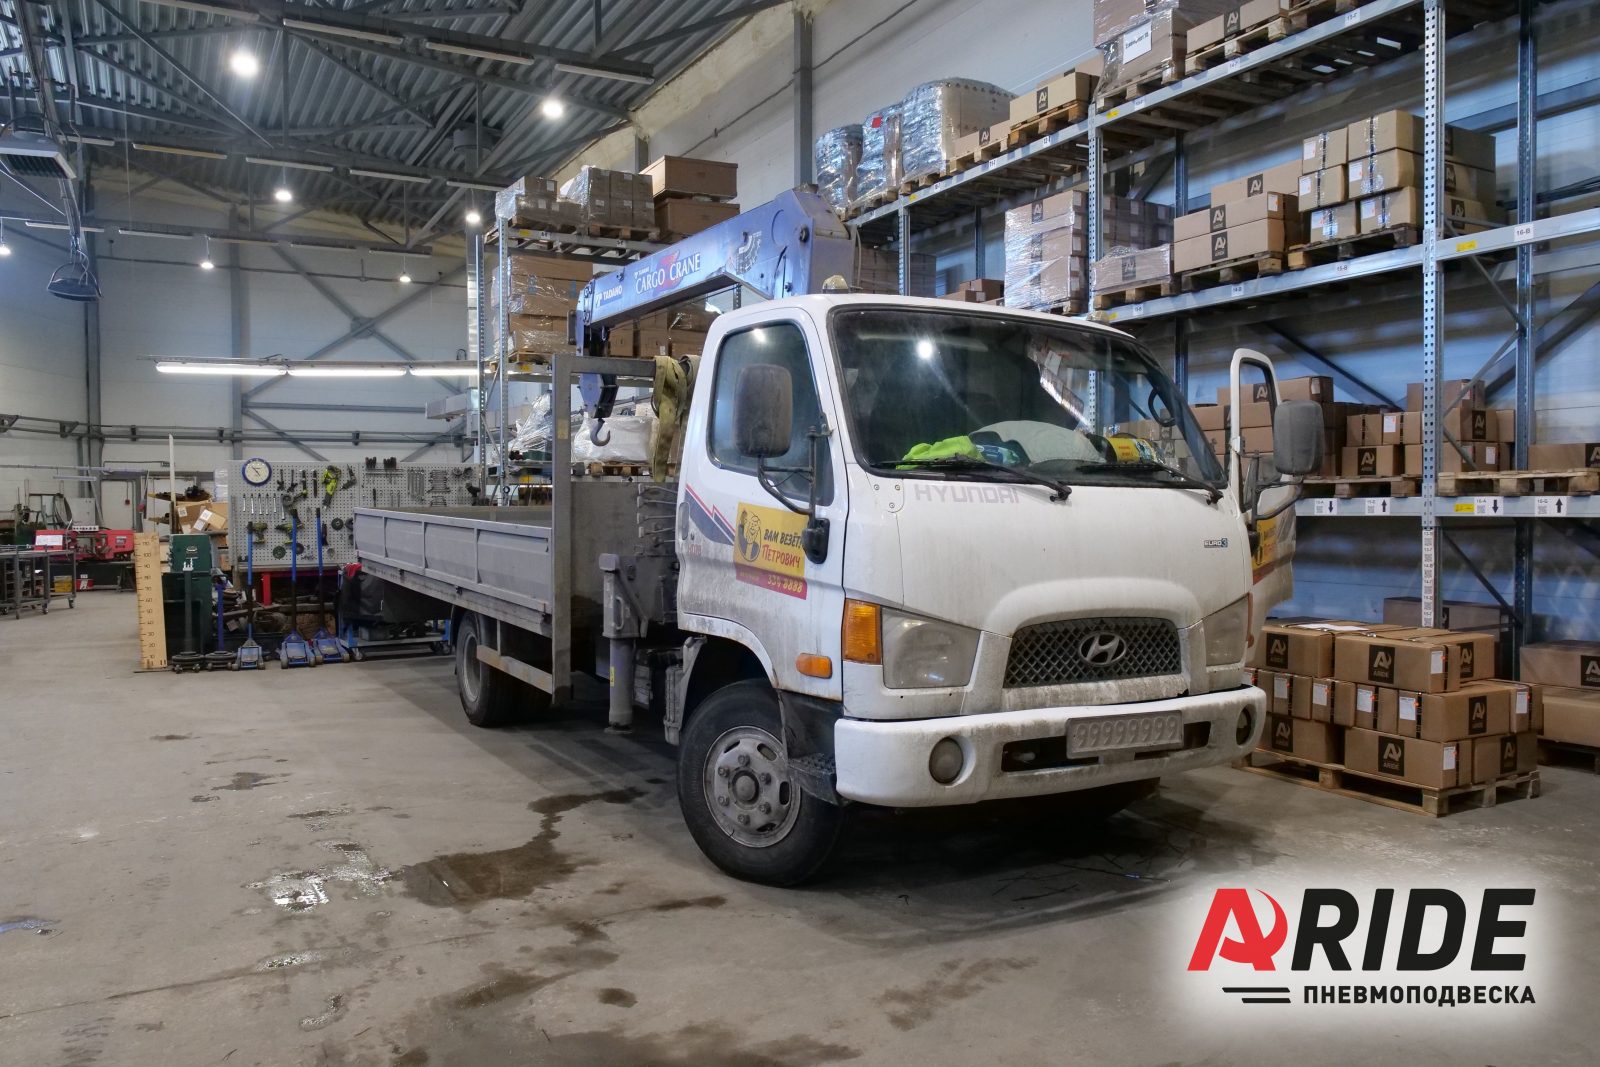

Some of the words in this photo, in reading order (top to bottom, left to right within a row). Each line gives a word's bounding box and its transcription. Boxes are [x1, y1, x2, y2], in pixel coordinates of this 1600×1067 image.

[635, 268, 666, 295] CARGO
[669, 252, 701, 281] CRANE
[603, 284, 623, 301] TADANO
[914, 484, 1020, 504] HYUNDAI
[764, 528, 779, 543] ВАМ
[762, 544, 801, 568] ПЕТРОВИЧ
